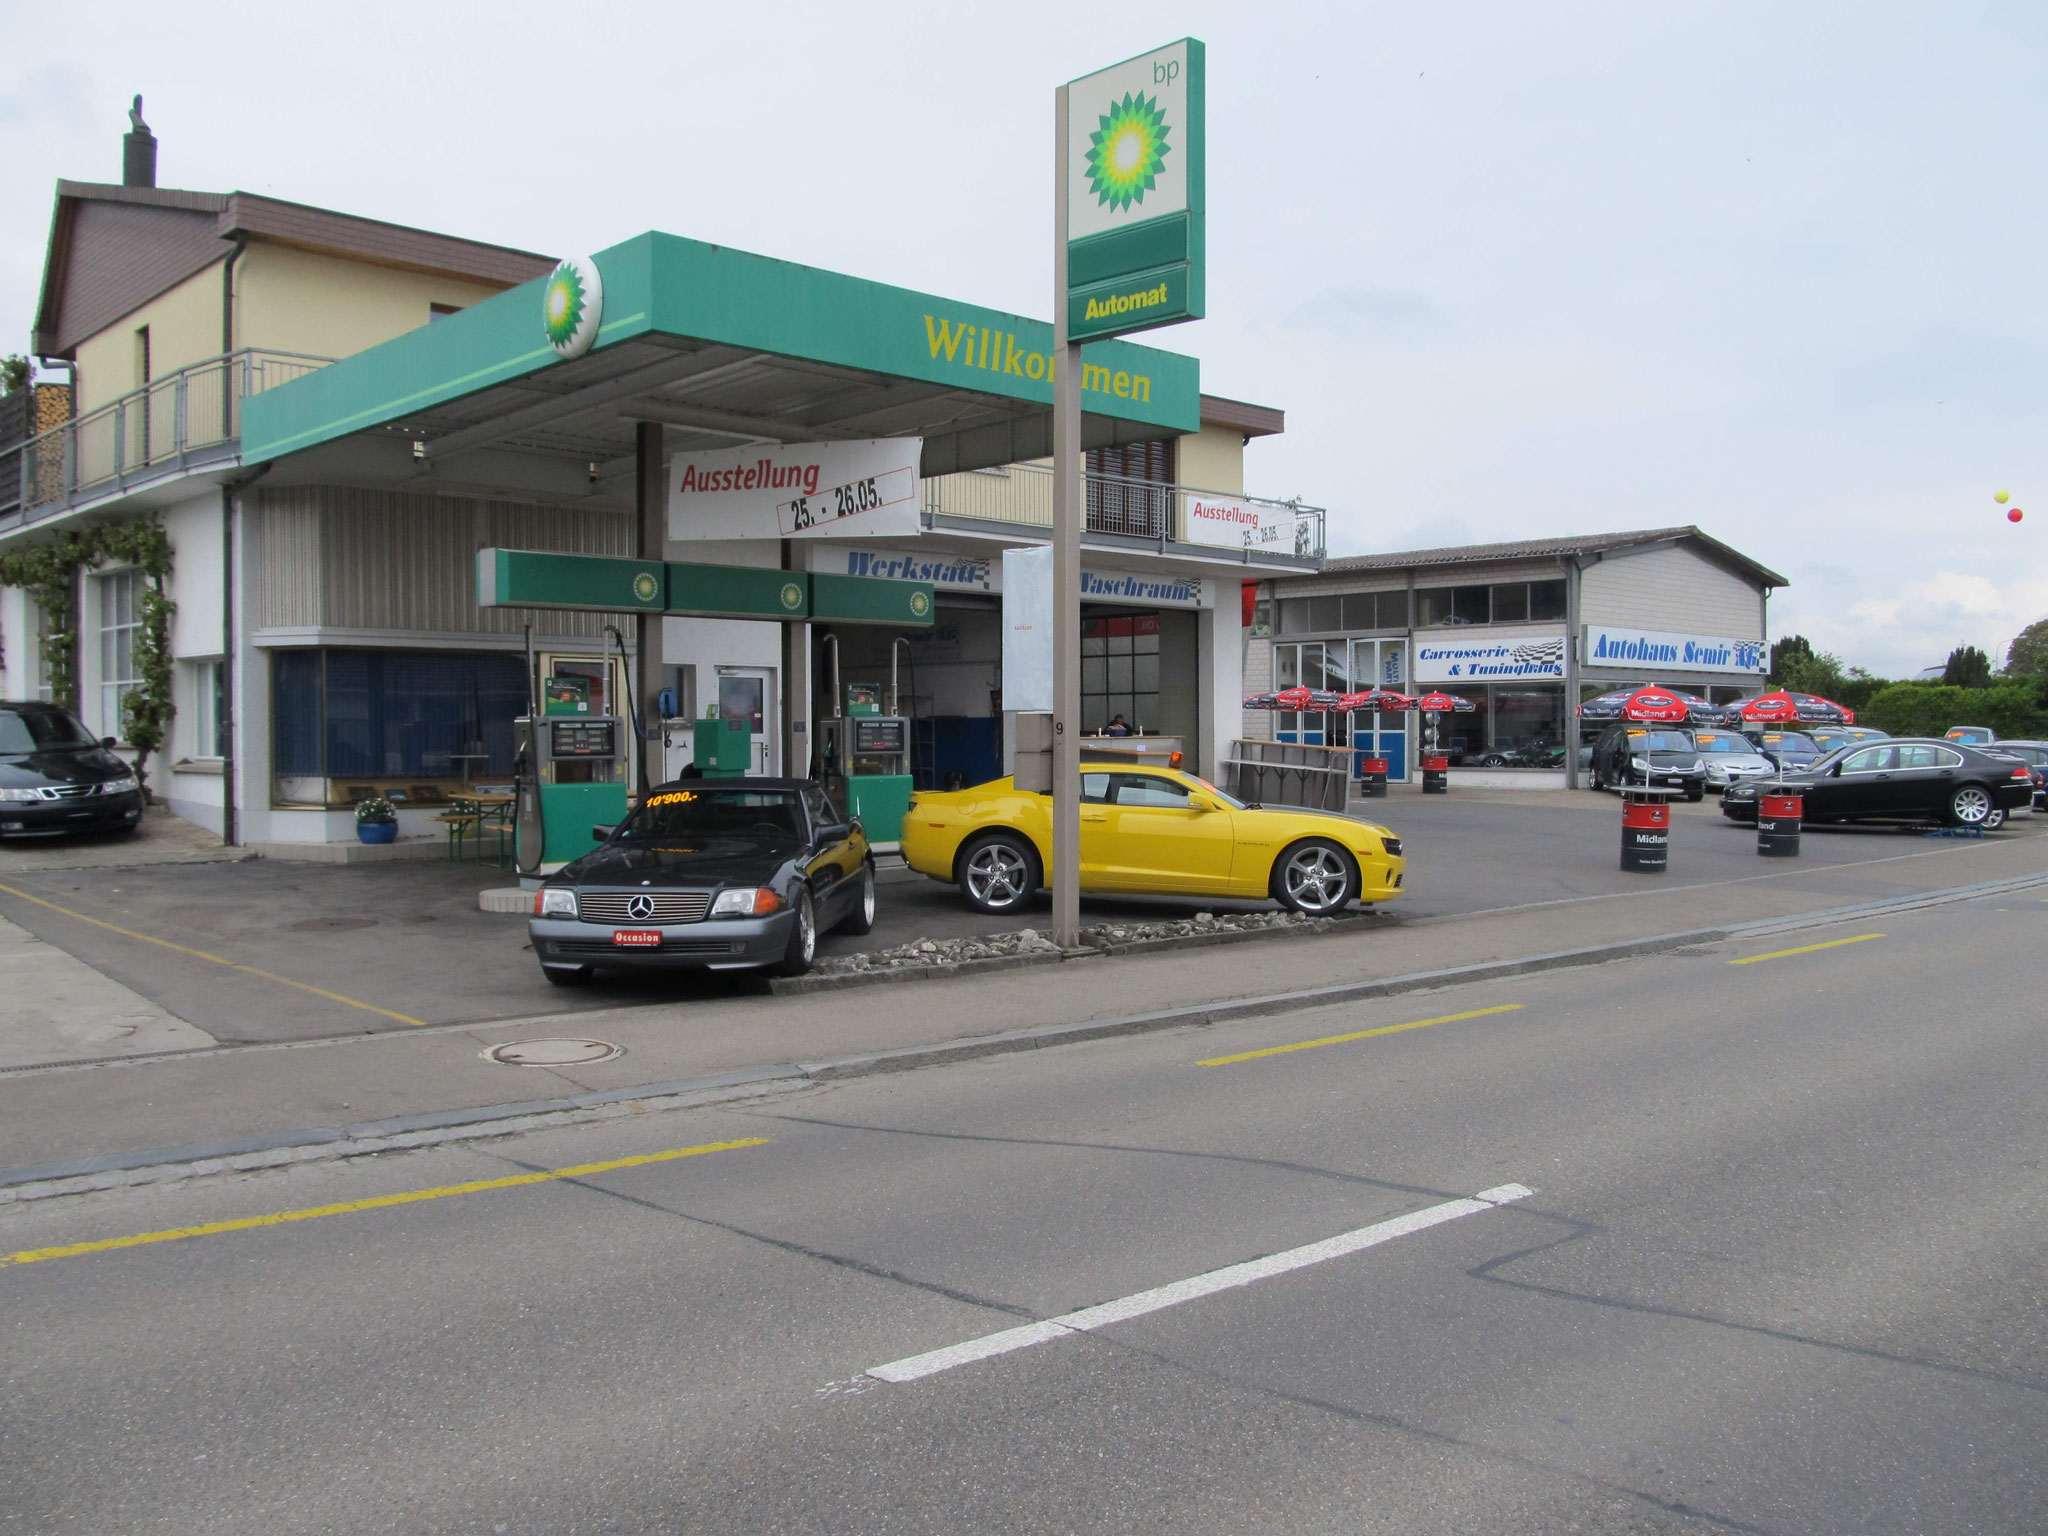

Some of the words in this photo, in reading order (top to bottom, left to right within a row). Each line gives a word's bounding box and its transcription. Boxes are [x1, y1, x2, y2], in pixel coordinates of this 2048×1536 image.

[1153, 60, 1179, 86] bp
[1085, 283, 1167, 320] Automat
[923, 314, 1150, 402] Willkomen
[681, 459, 820, 496] Ausstellung
[791, 498, 815, 531] 25.
[835, 478, 883, 519] 26.05.
[1193, 502, 1259, 529] Ausstellung
[1261, 526, 1278, 542] 26.05.
[848, 552, 977, 583] Werkstatt
[1419, 646, 1510, 660] Carrosserie
[1594, 634, 1678, 662] Autohaus
[1683, 641, 1731, 666] Semir
[1735, 644, 1760, 669] AG
[1448, 664, 1461, 675] &
[1468, 661, 1562, 676] Tuninghaus
[1631, 709, 1667, 719] Midland
[1746, 712, 1776, 720] Midland
[1056, 722, 1063, 735] 9
[646, 791, 698, 807] 10'900.-
[616, 932, 659, 942] Occasion
